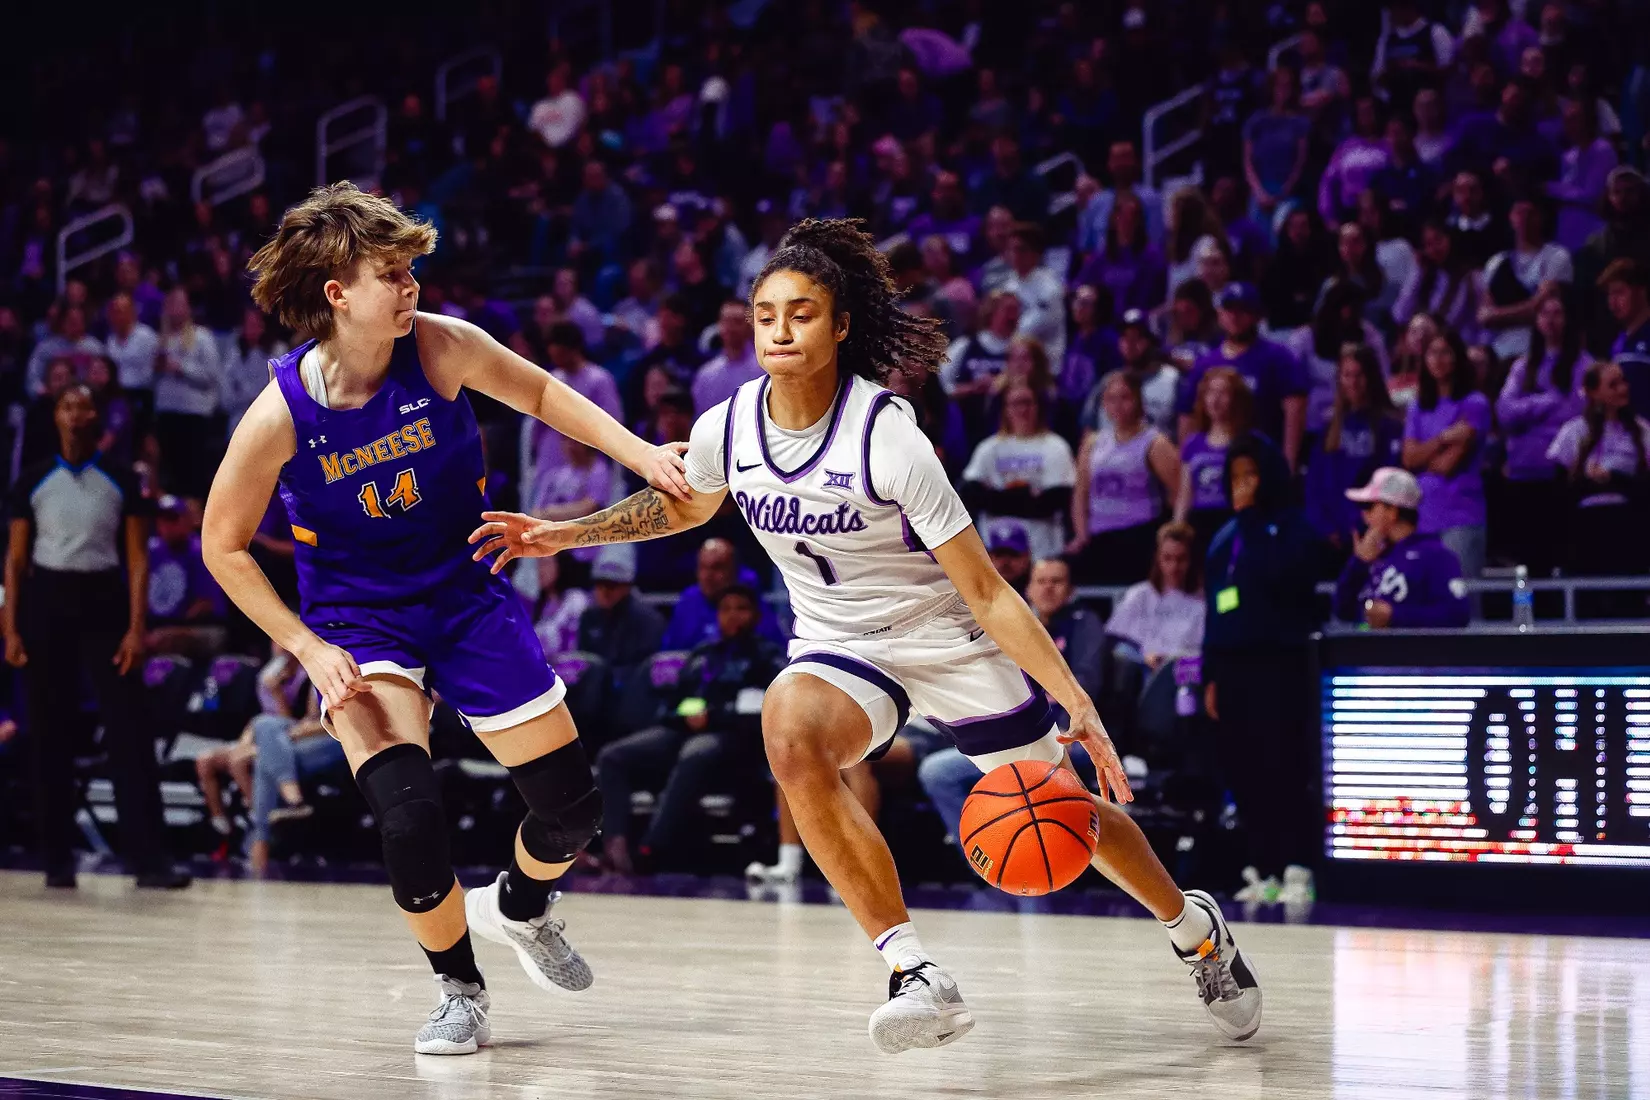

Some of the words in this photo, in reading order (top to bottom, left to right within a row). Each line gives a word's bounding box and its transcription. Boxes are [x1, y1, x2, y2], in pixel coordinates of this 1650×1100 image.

[399, 398, 431, 415] SLC
[357, 467, 423, 519] 14
[736, 490, 869, 535] Wildcats
[793, 540, 842, 587] 1
